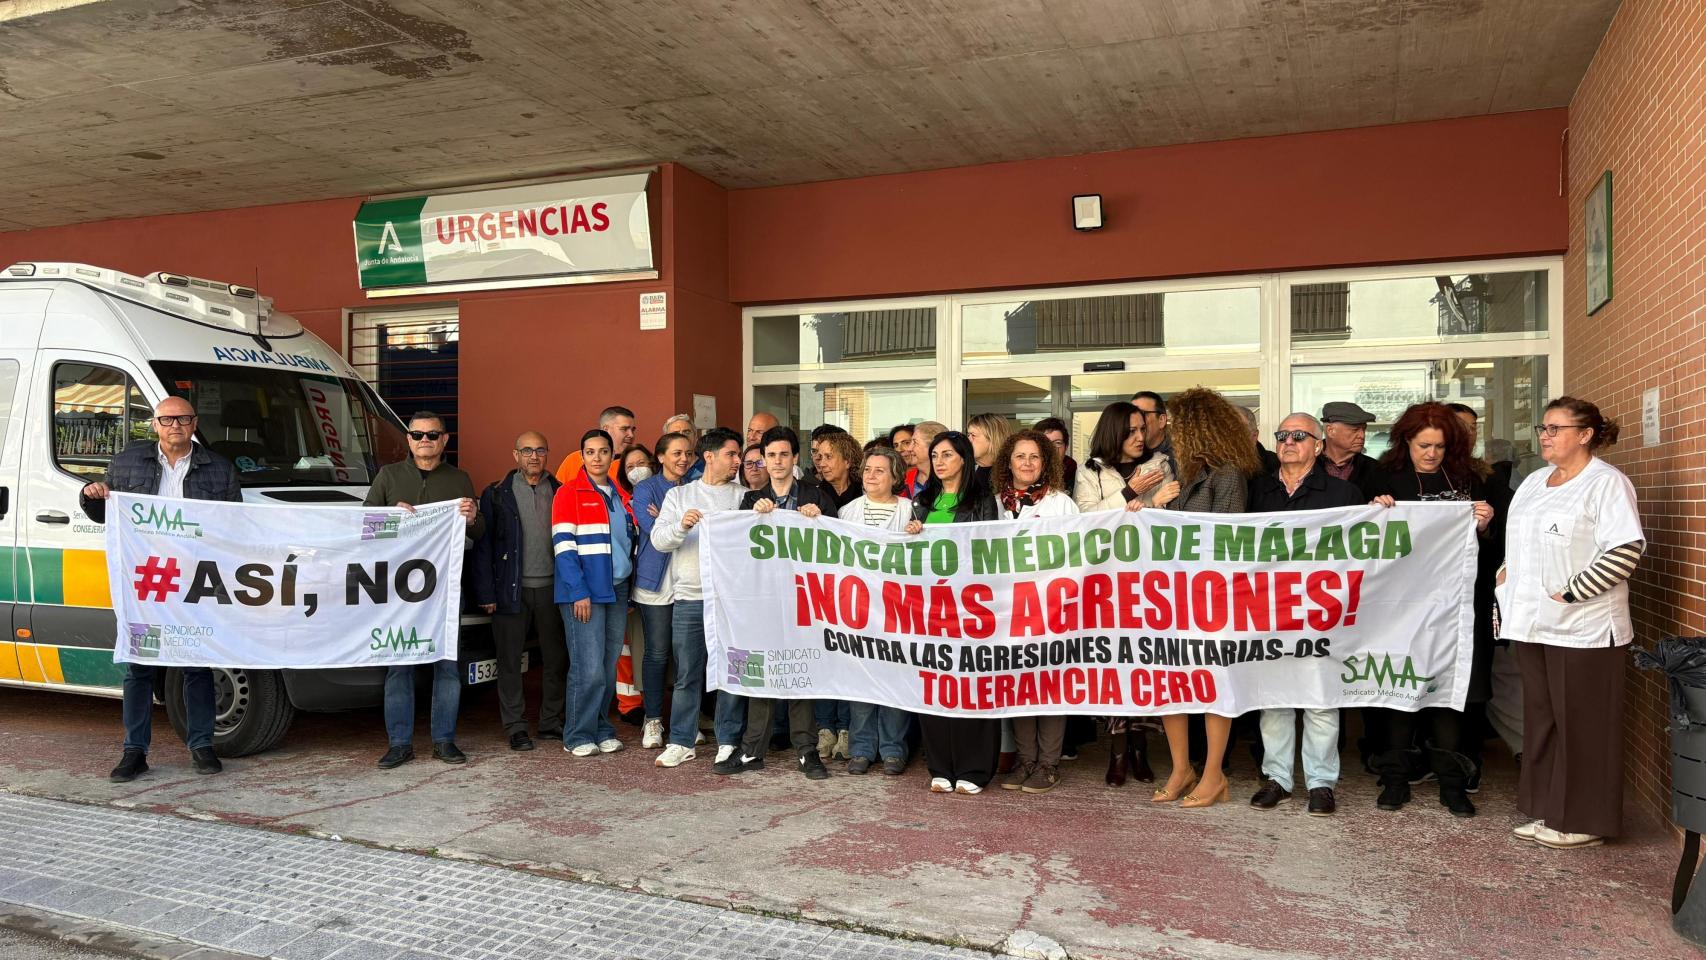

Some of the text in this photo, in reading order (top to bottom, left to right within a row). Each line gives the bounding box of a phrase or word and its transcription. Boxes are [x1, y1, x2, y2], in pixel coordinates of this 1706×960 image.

[436, 203, 610, 245] URGENCIAS
[131, 502, 199, 531] SMA
[749, 520, 1413, 577] SINDICATO MÉDICO DE MÁLAGA
[134, 553, 437, 618] #ASÍ, NO
[795, 569, 1365, 640] ¡NO MÁS AGRESIONES!
[164, 624, 214, 636] SINDICATO
[370, 625, 432, 652] SMA
[768, 648, 821, 661] SINDICATO
[823, 628, 1331, 673] CONTRA LAS AGRESIONES A SANITARIAS-OS
[769, 662, 809, 675] MÉDICO
[770, 676, 813, 689] MÁLAGA
[1341, 650, 1435, 690] SMA
[919, 667, 1218, 711] TOLERANCIA CERO
[1378, 689, 1404, 699] Médico
